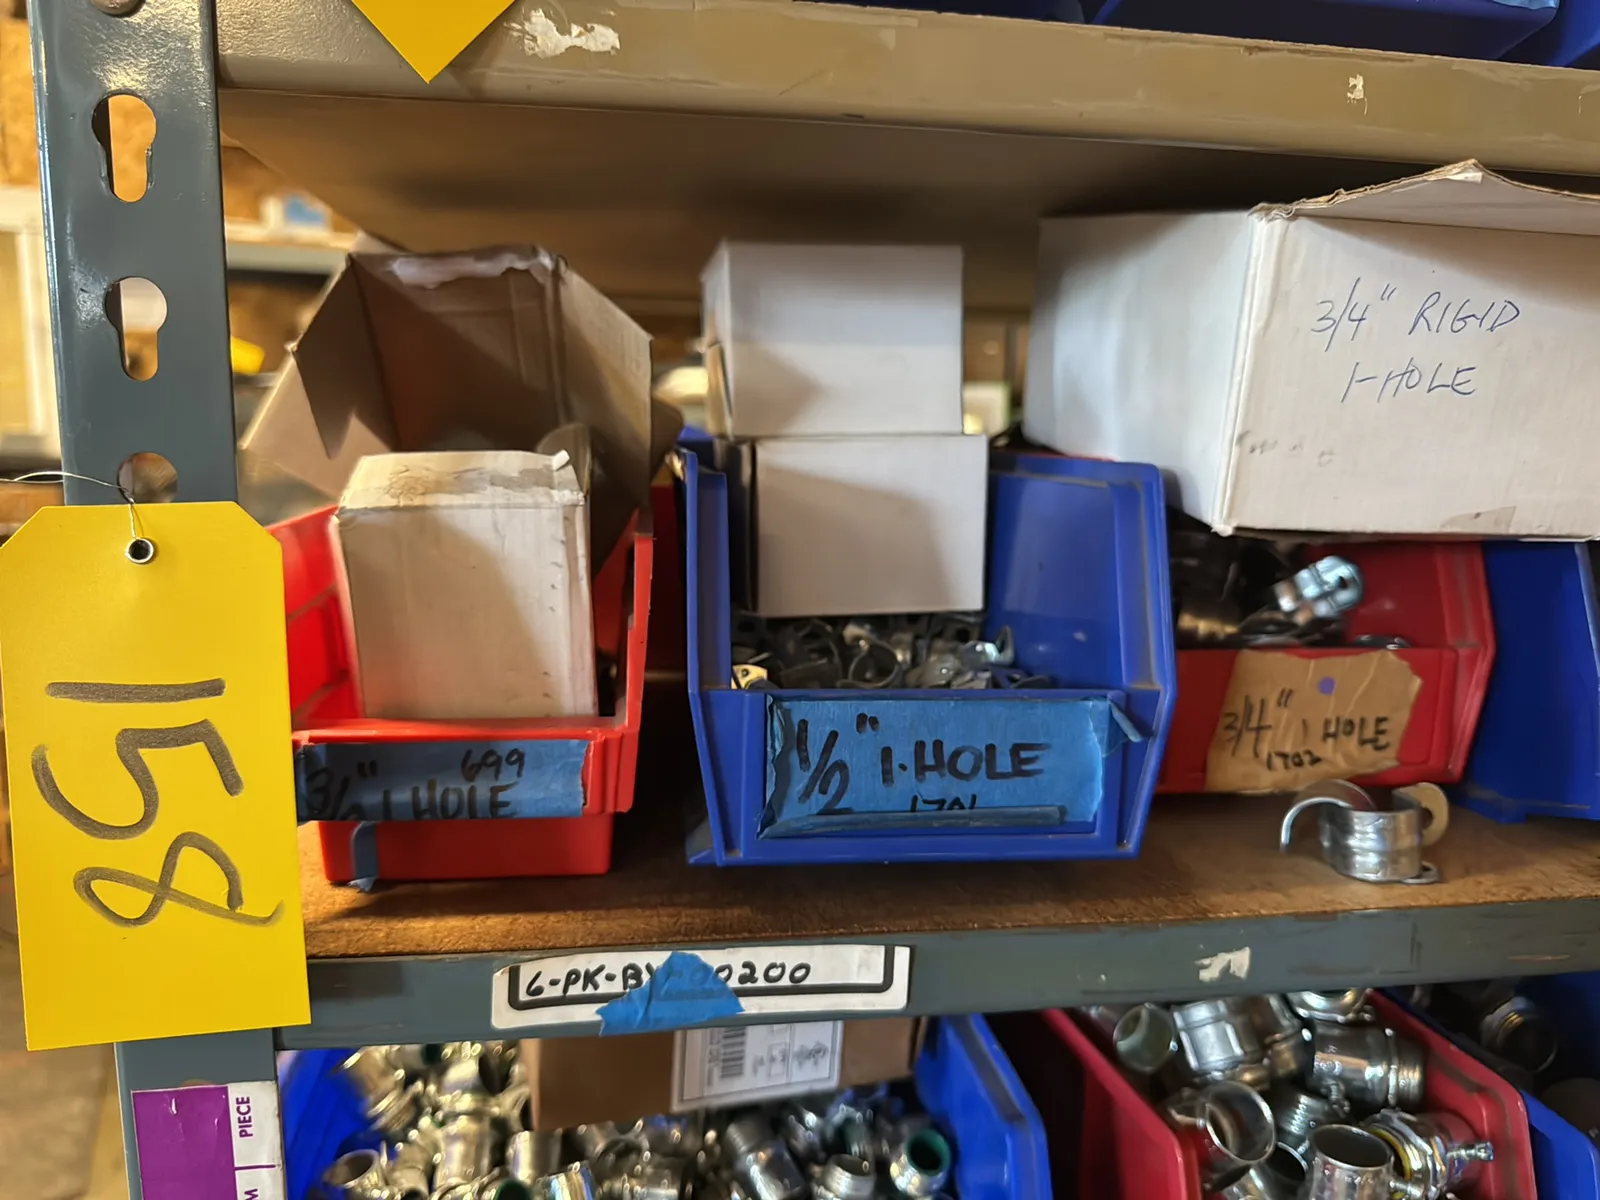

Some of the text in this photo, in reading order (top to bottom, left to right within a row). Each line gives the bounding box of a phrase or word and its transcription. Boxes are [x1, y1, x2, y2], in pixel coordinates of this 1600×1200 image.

[1408, 291, 1520, 335] RIGID
[1341, 357, 1478, 403] 1-HOLE
[1320, 716, 1391, 752] HOLE
[460, 748, 526, 782] 699
[31, 677, 285, 928] 158
[411, 778, 519, 820] HOLE
[235, 1096, 254, 1138] PIECE
